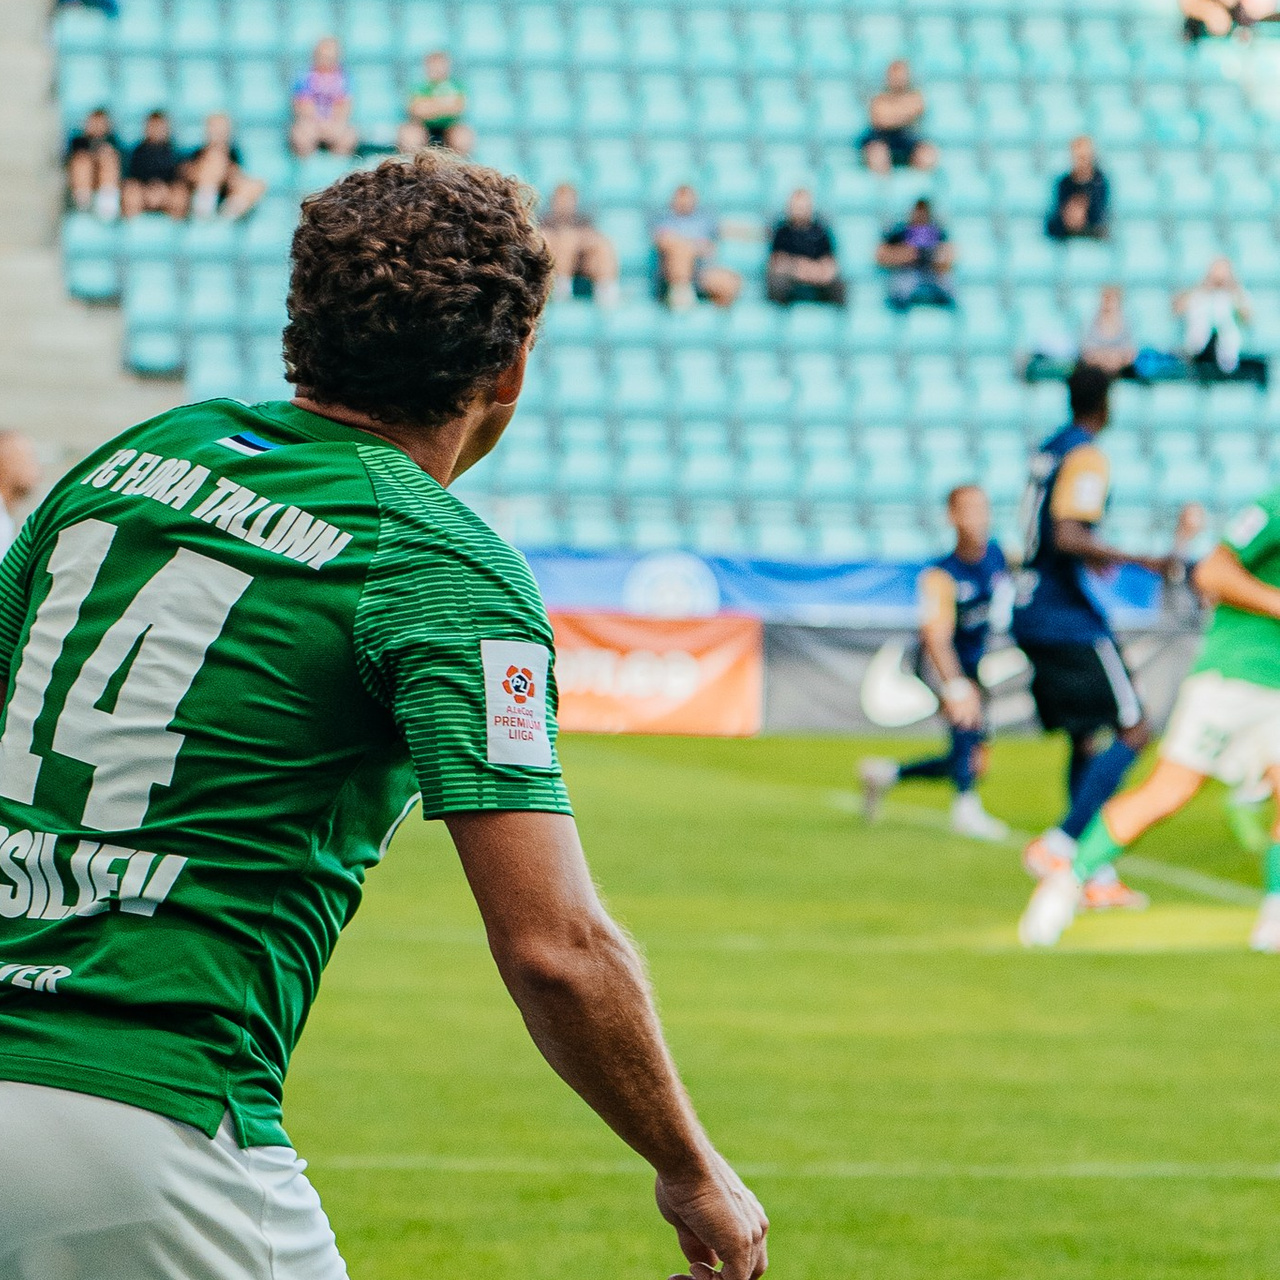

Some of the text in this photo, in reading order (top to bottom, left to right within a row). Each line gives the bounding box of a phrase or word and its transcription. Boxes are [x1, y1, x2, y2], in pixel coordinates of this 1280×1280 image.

[80, 448, 354, 571] FC FLORA TALLINN
[493, 715, 542, 731] PREMIUM
[508, 729, 535, 742] LIIGA
